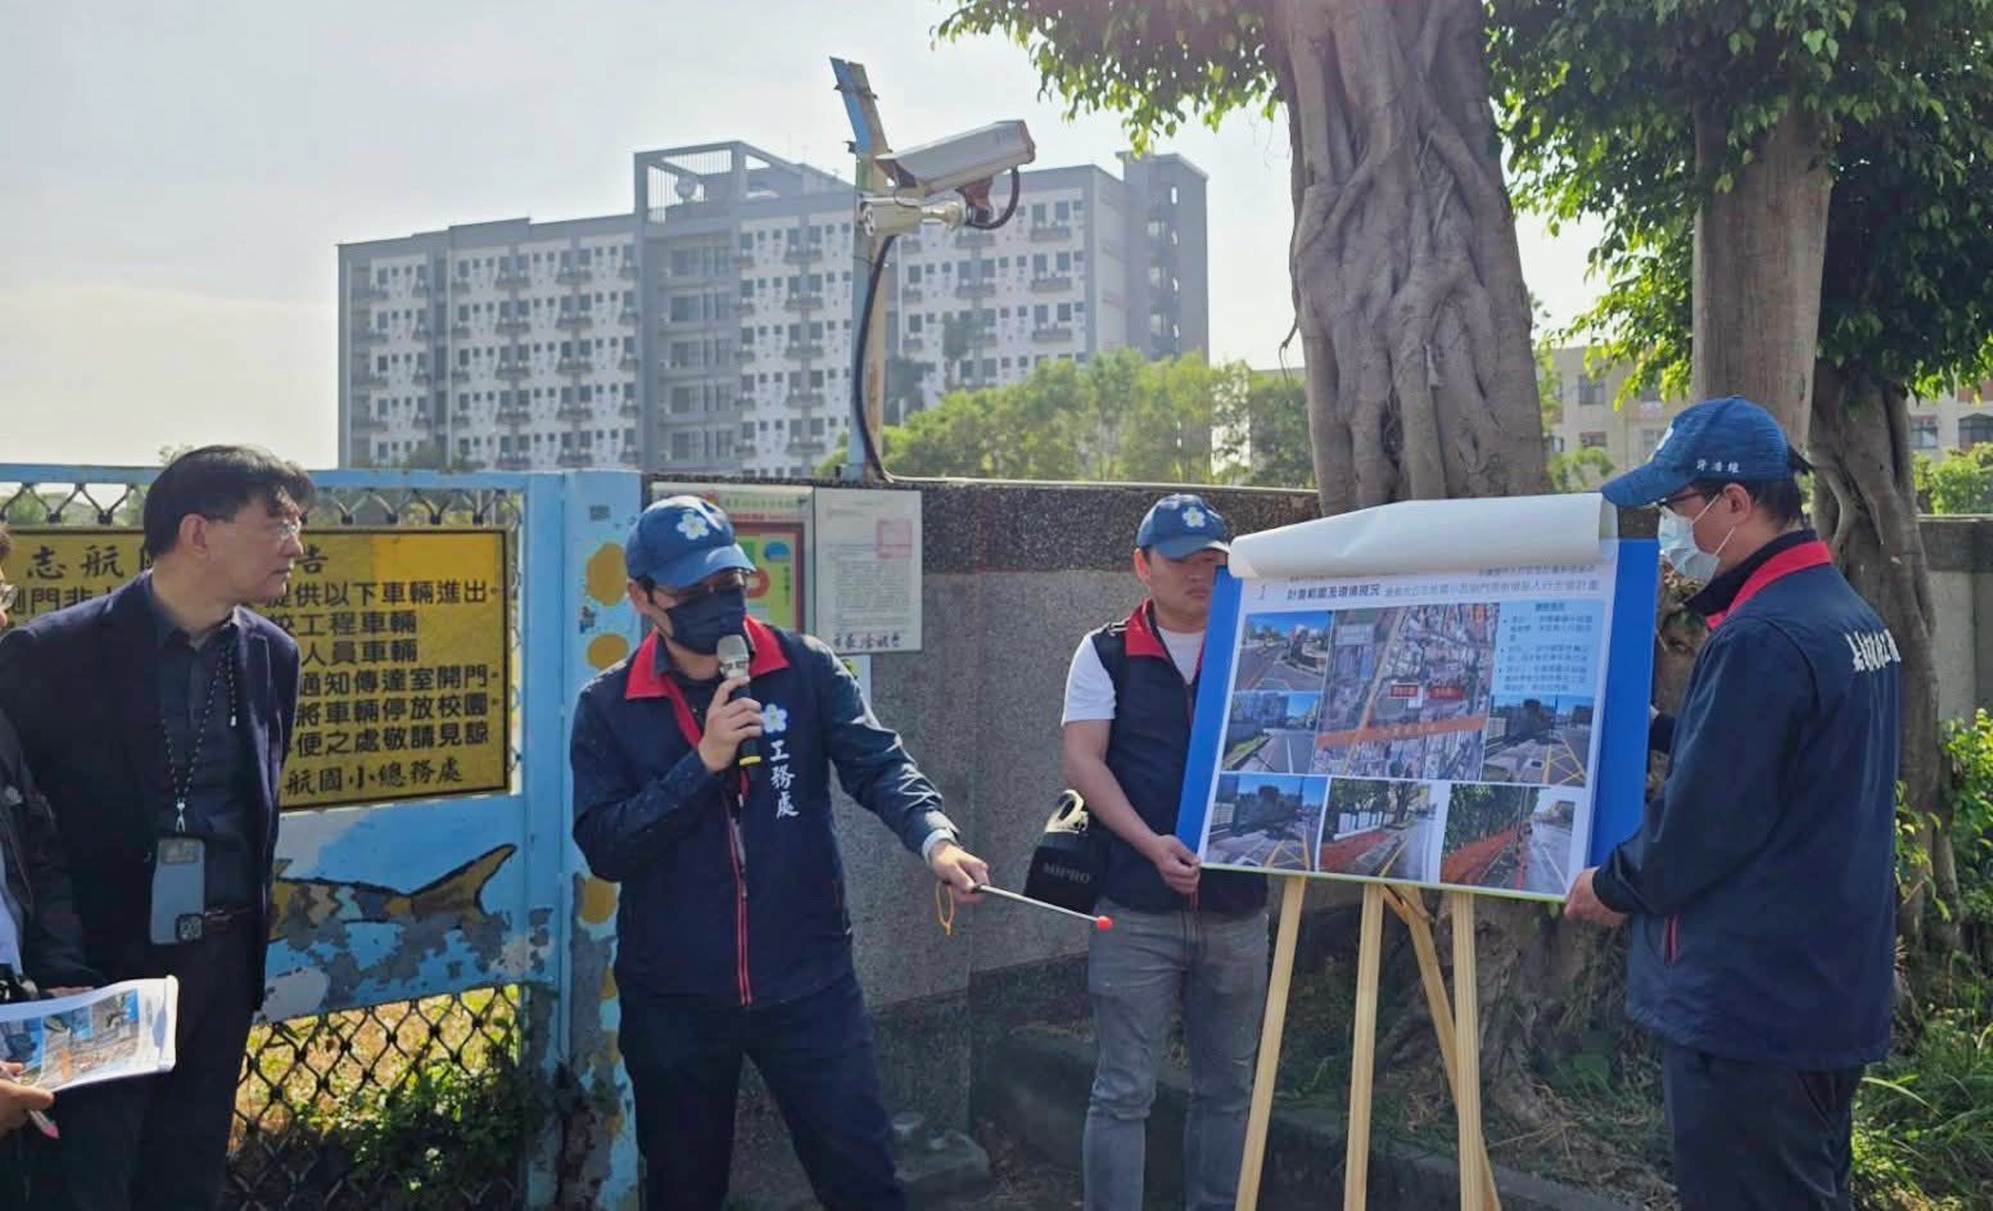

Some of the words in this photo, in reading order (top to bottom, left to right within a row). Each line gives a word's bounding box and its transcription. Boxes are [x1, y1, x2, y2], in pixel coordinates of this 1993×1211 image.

[301, 638, 418, 667] 人員車輛
[769, 739, 800, 820] 工務處
[1043, 862, 1091, 884] MIPRO
